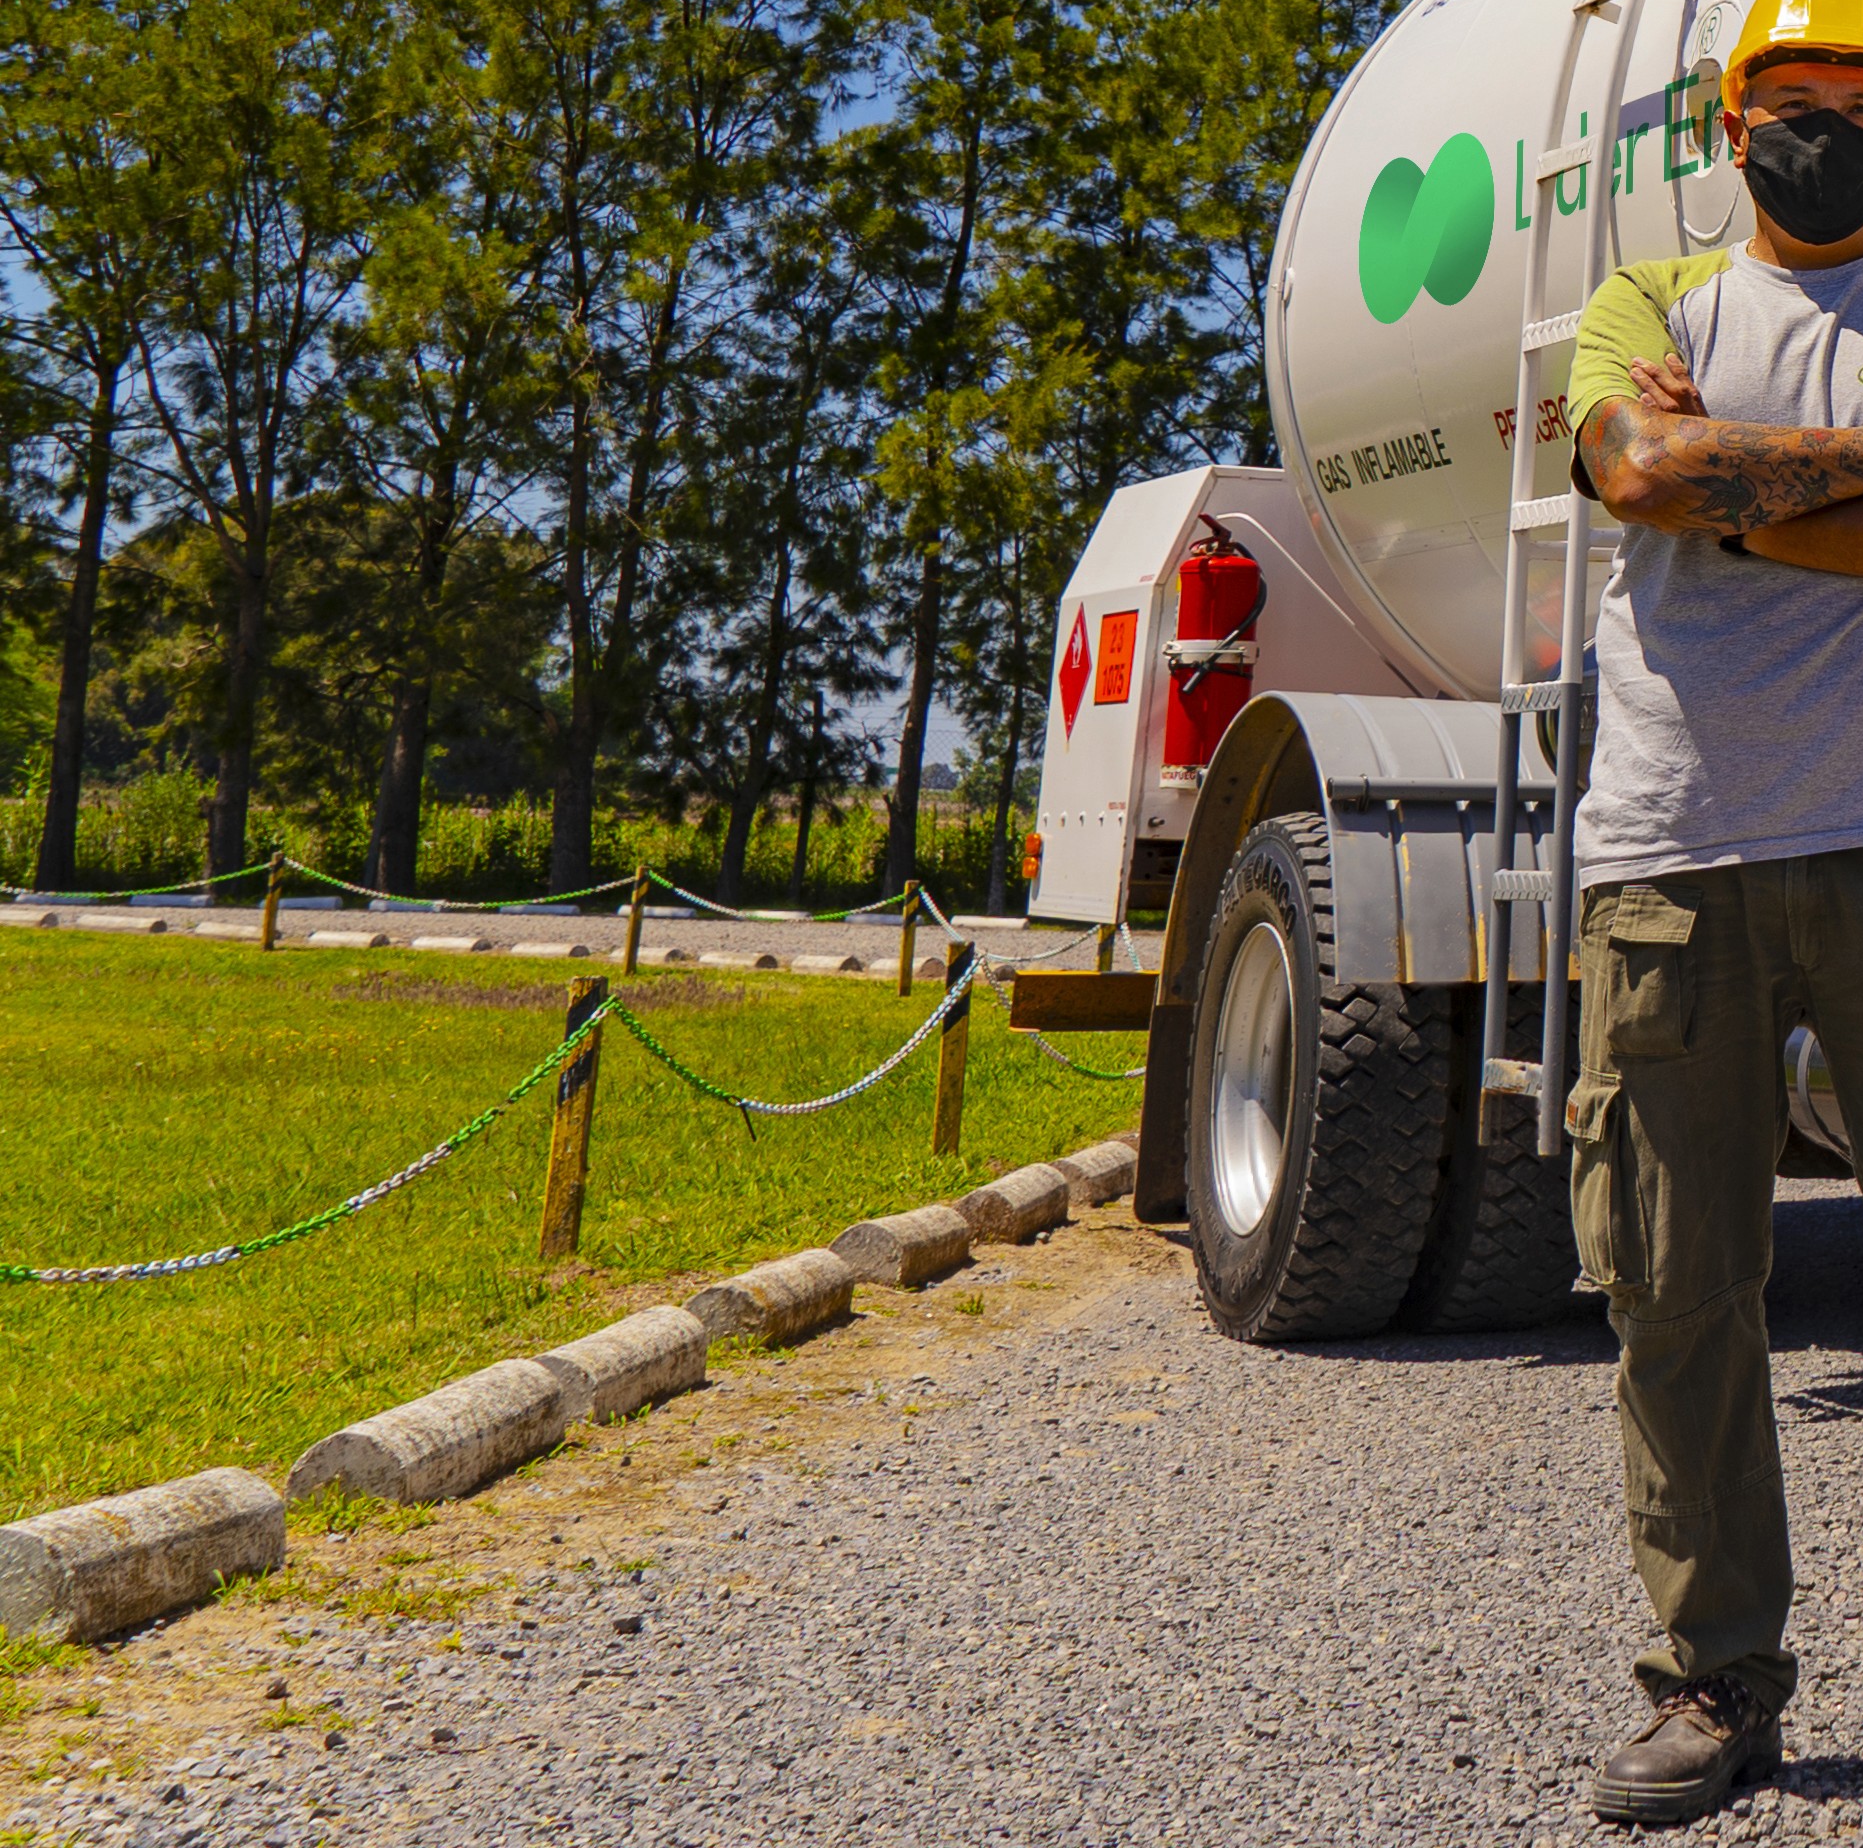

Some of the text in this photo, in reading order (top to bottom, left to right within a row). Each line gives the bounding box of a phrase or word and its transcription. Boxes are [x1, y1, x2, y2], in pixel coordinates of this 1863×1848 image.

[1316, 428, 1453, 493] GAS INFLAMABLE
[1110, 623, 1126, 654] 23
[1102, 663, 1126, 696] 1075
